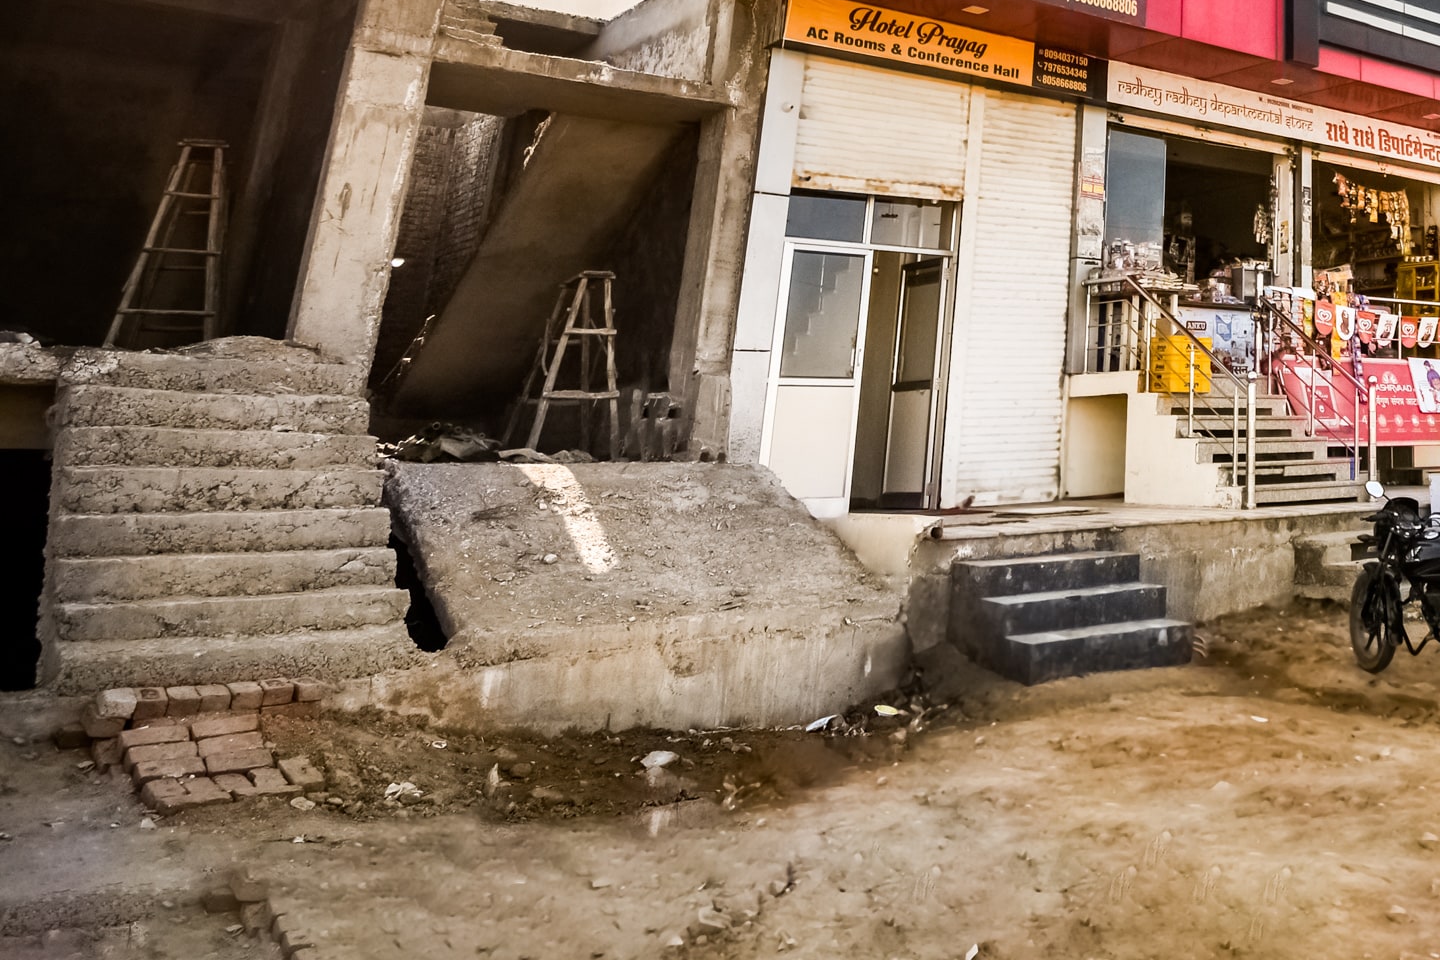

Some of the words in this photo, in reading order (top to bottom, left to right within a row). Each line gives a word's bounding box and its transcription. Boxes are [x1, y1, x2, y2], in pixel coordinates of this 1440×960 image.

[848, 7, 915, 39] Hotel
[916, 21, 988, 59] Prayag
[806, 26, 829, 41] AC
[834, 31, 886, 53] Rooms
[891, 43, 902, 56] &
[907, 45, 989, 73] Conference
[993, 64, 1020, 80] Hall
[1044, 48, 1089, 67] 8094037150
[1043, 61, 1088, 80] 7976534346
[1118, 77, 1163, 106] radhey
[1165, 86, 1208, 116] radhey
[1210, 93, 1283, 125] departmental
[1285, 115, 1314, 132] store
[1325, 120, 1350, 145] राधे
[1352, 126, 1376, 151] राधे
[1375, 383, 1413, 393] ASHIRVAAD
